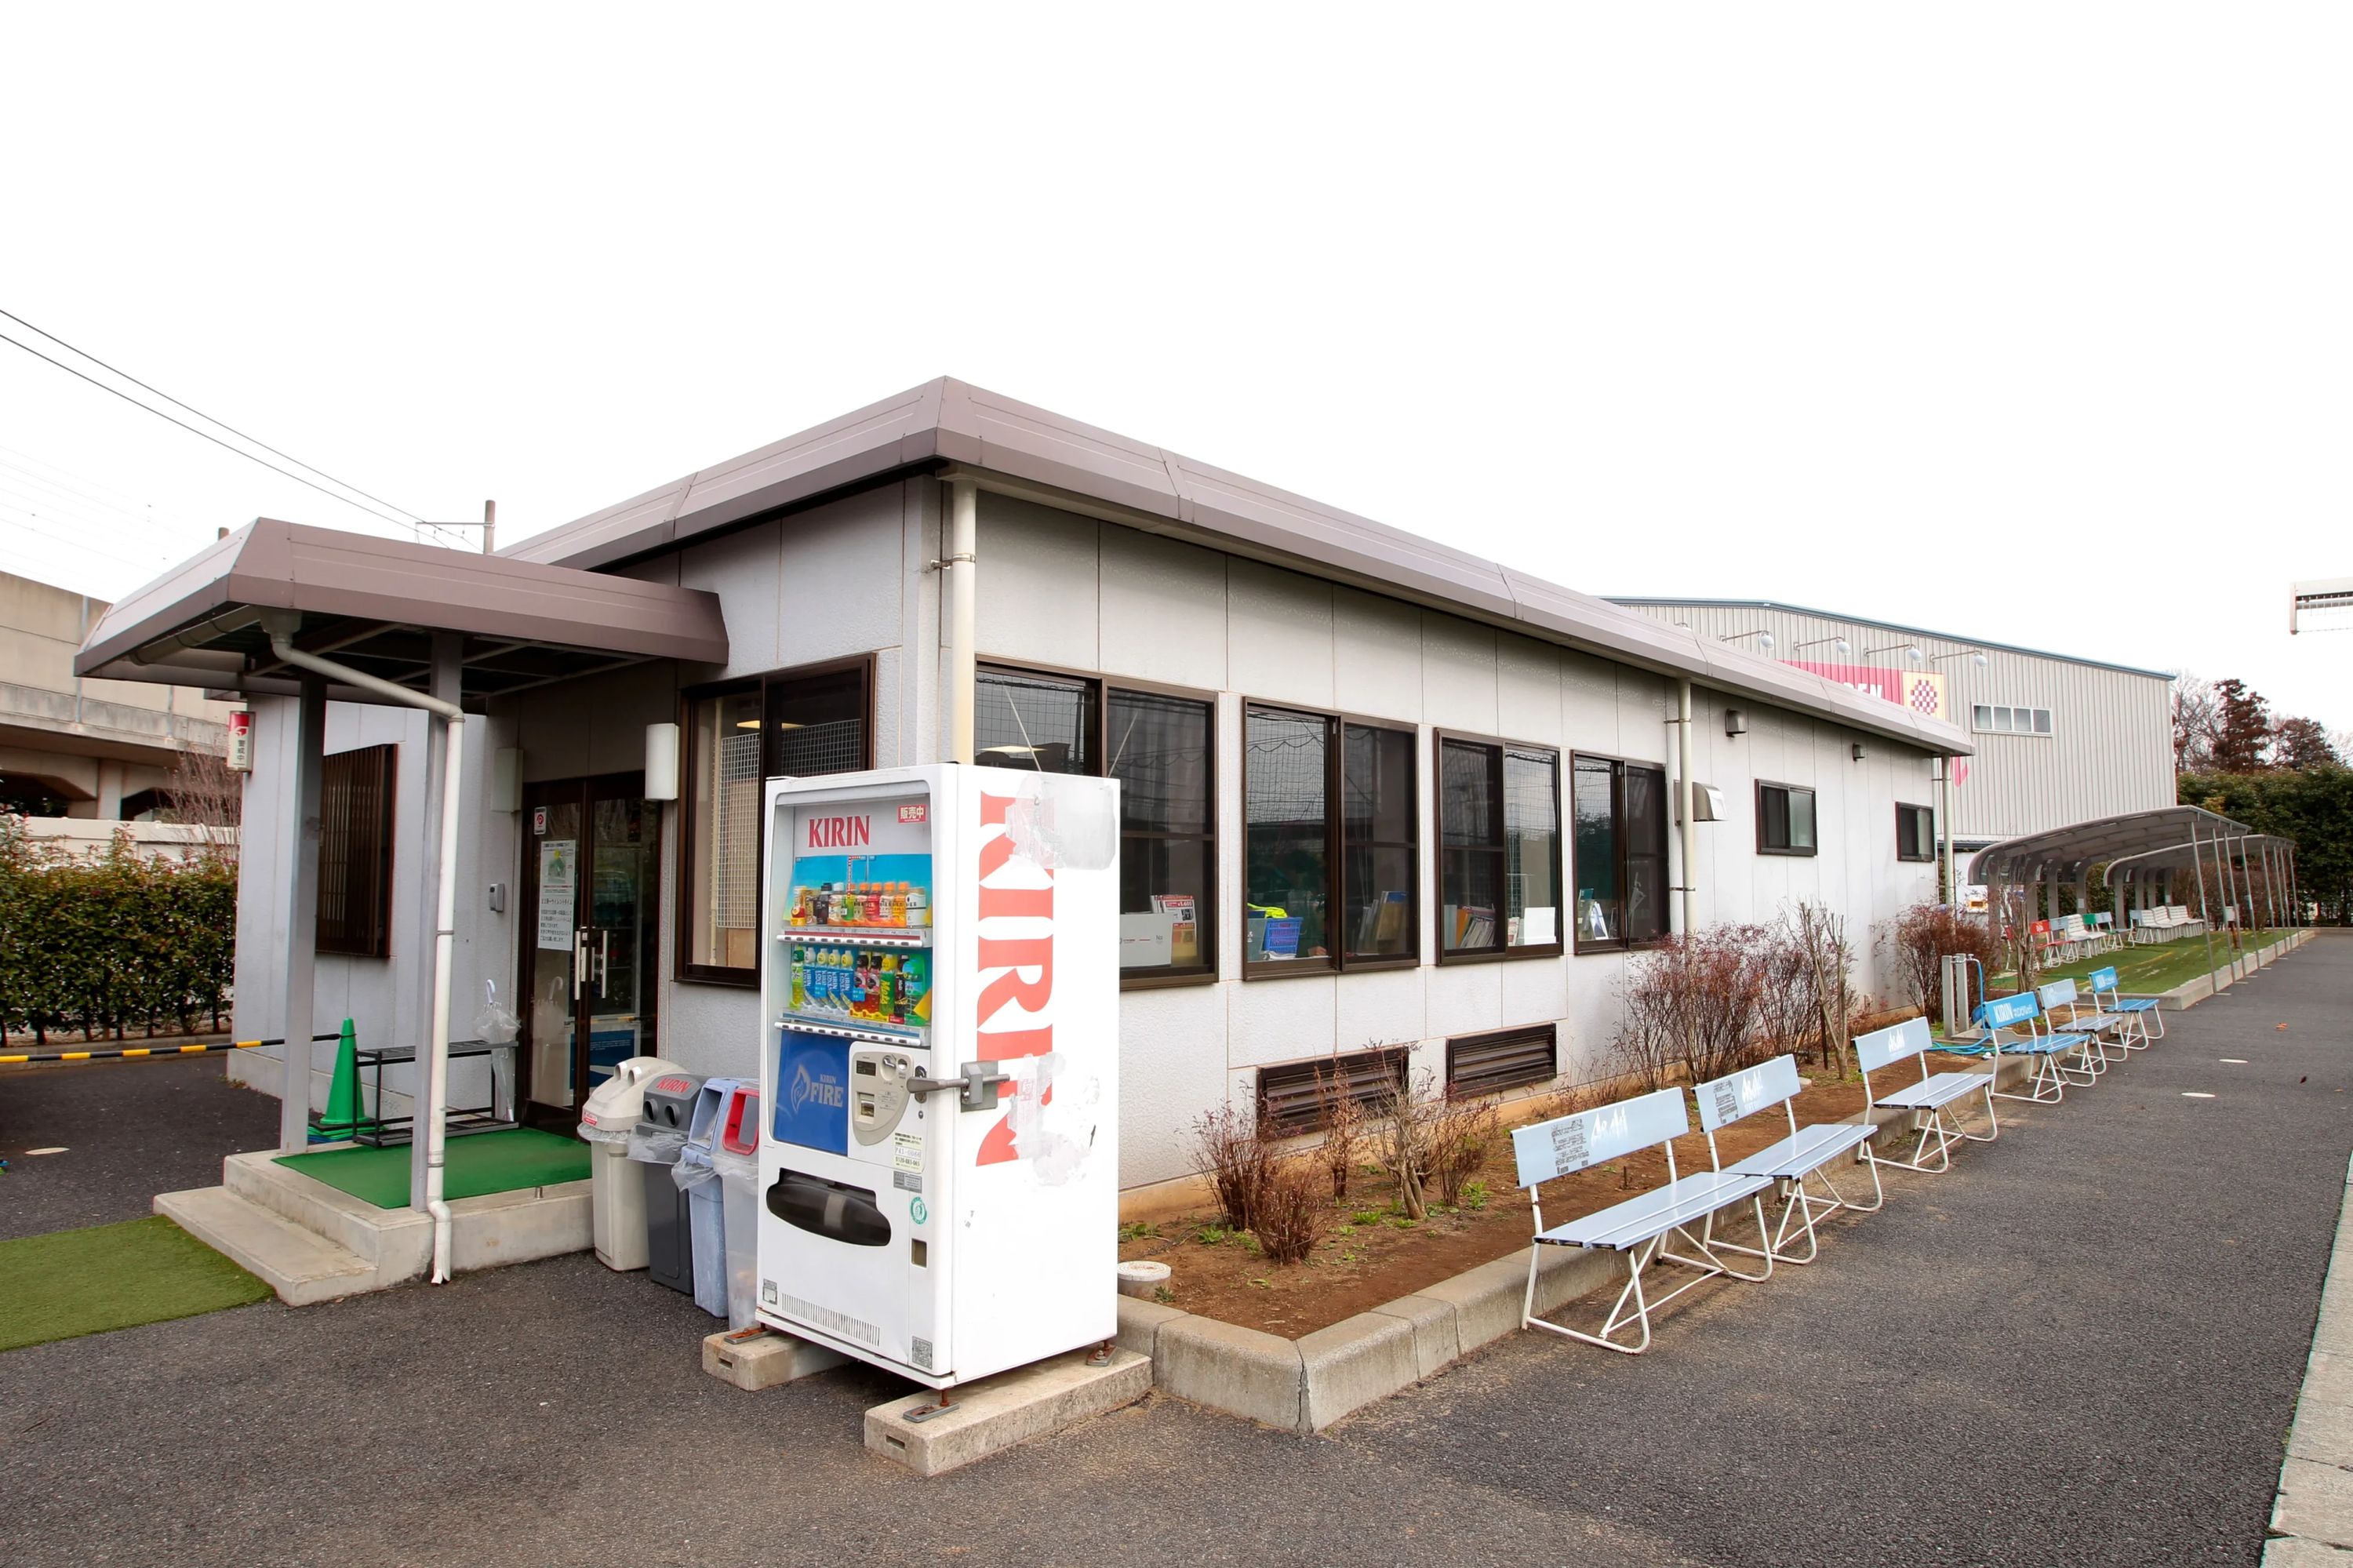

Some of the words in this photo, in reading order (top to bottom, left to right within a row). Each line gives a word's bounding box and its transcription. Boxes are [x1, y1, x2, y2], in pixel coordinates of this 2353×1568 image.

[900, 806, 925, 820] 販売中
[808, 815, 871, 848] KIRIN
[1993, 1002, 2014, 1023] KIRIN
[656, 1077, 692, 1093] KIRIN
[820, 1073, 836, 1085] KIRIN
[809, 1082, 844, 1108] FIRE
